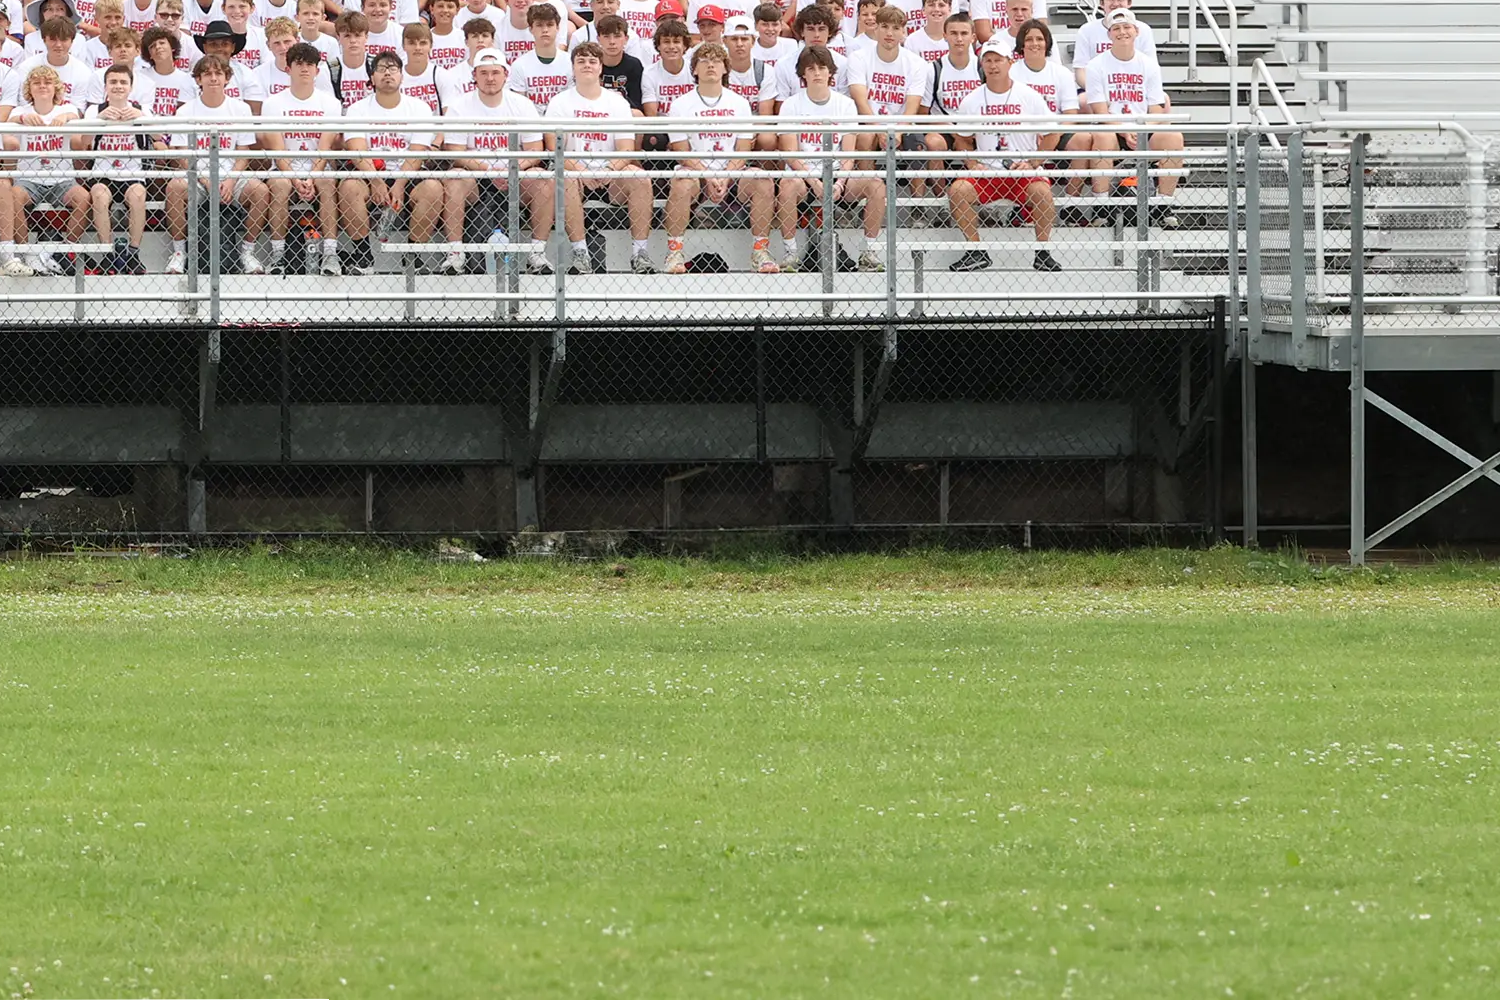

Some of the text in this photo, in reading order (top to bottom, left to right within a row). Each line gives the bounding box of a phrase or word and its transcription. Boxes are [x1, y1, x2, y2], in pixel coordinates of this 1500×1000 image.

[505, 41, 534, 51] LEGEND
[428, 48, 465, 58] LEGENDS
[527, 76, 567, 86] LEGENDS
[872, 72, 905, 85] EGENDS
[1108, 74, 1143, 84] LEGENDS
[659, 85, 694, 95] LEGEND
[942, 81, 982, 91] LEGENDS
[868, 89, 905, 104] MAKING
[1109, 91, 1143, 102] MAKING
[981, 105, 1021, 115] LEGENDS
[371, 137, 406, 148] MAKING
[475, 137, 507, 148] MAKIN
[800, 132, 839, 144] MAKG
[28, 138, 63, 151] MAKING
[197, 139, 231, 149] MANG
